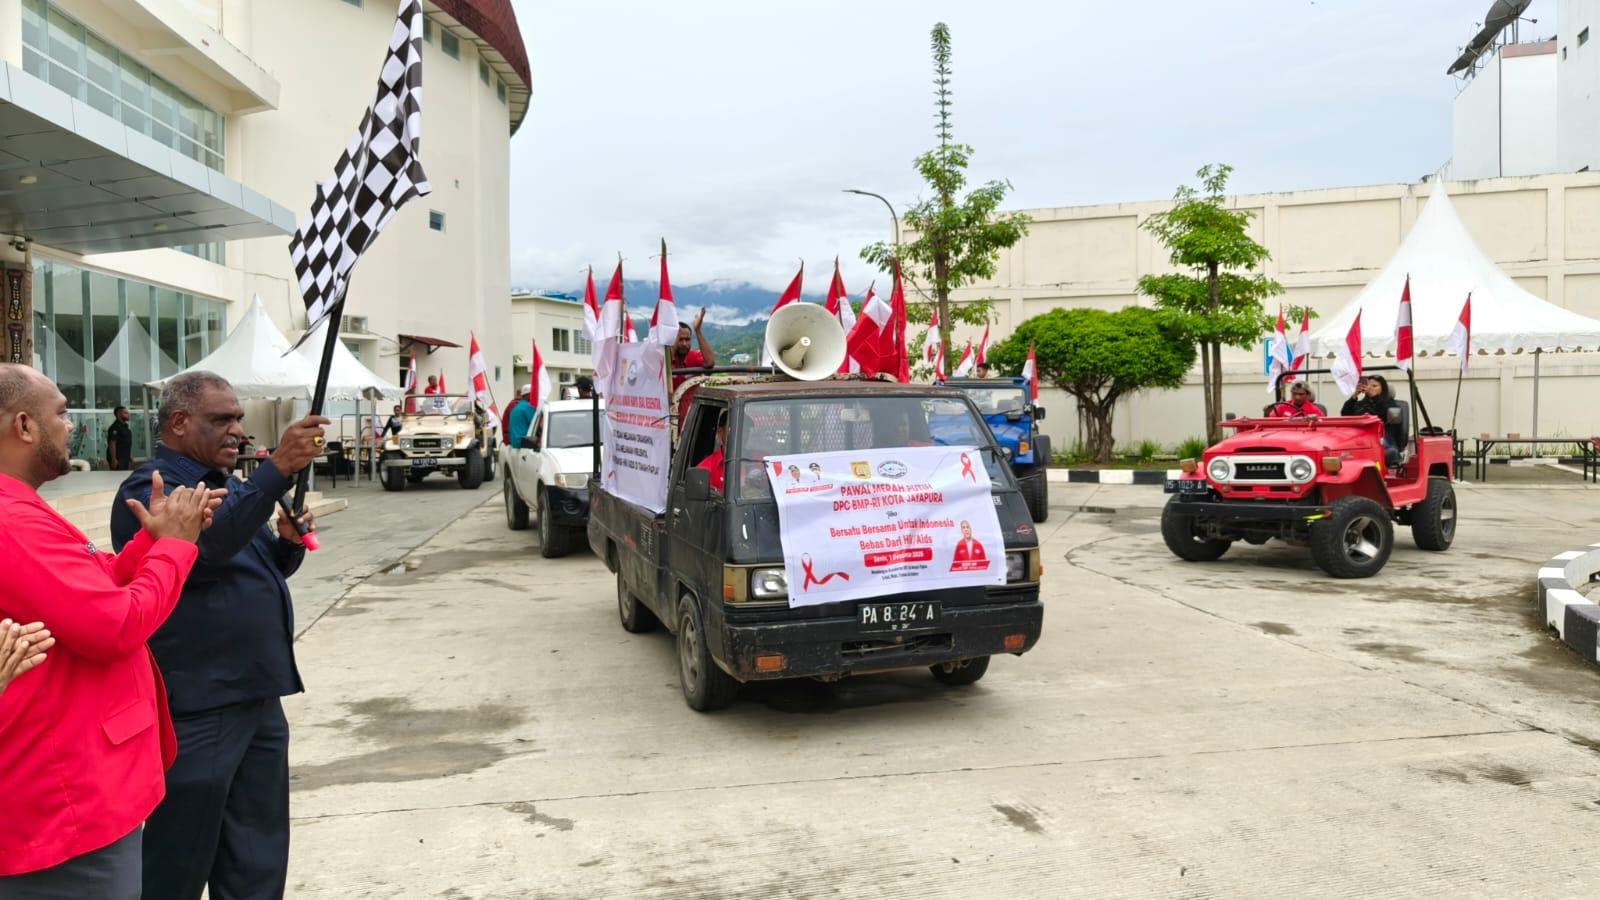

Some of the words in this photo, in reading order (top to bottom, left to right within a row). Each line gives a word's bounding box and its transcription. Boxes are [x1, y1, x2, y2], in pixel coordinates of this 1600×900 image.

[833, 501, 851, 512] DPC
[852, 498, 882, 510] BMP-RI
[882, 495, 906, 506] KOTA
[906, 492, 944, 503] JAYAPURA
[830, 526, 861, 538] Bersatu
[862, 523, 897, 534] Bersama
[897, 519, 918, 530] Untuk
[918, 518, 955, 530] Indonesia
[860, 539, 884, 550] Bebas
[886, 536, 902, 547] Dari
[863, 606, 878, 624] PA
[926, 604, 934, 620] A
